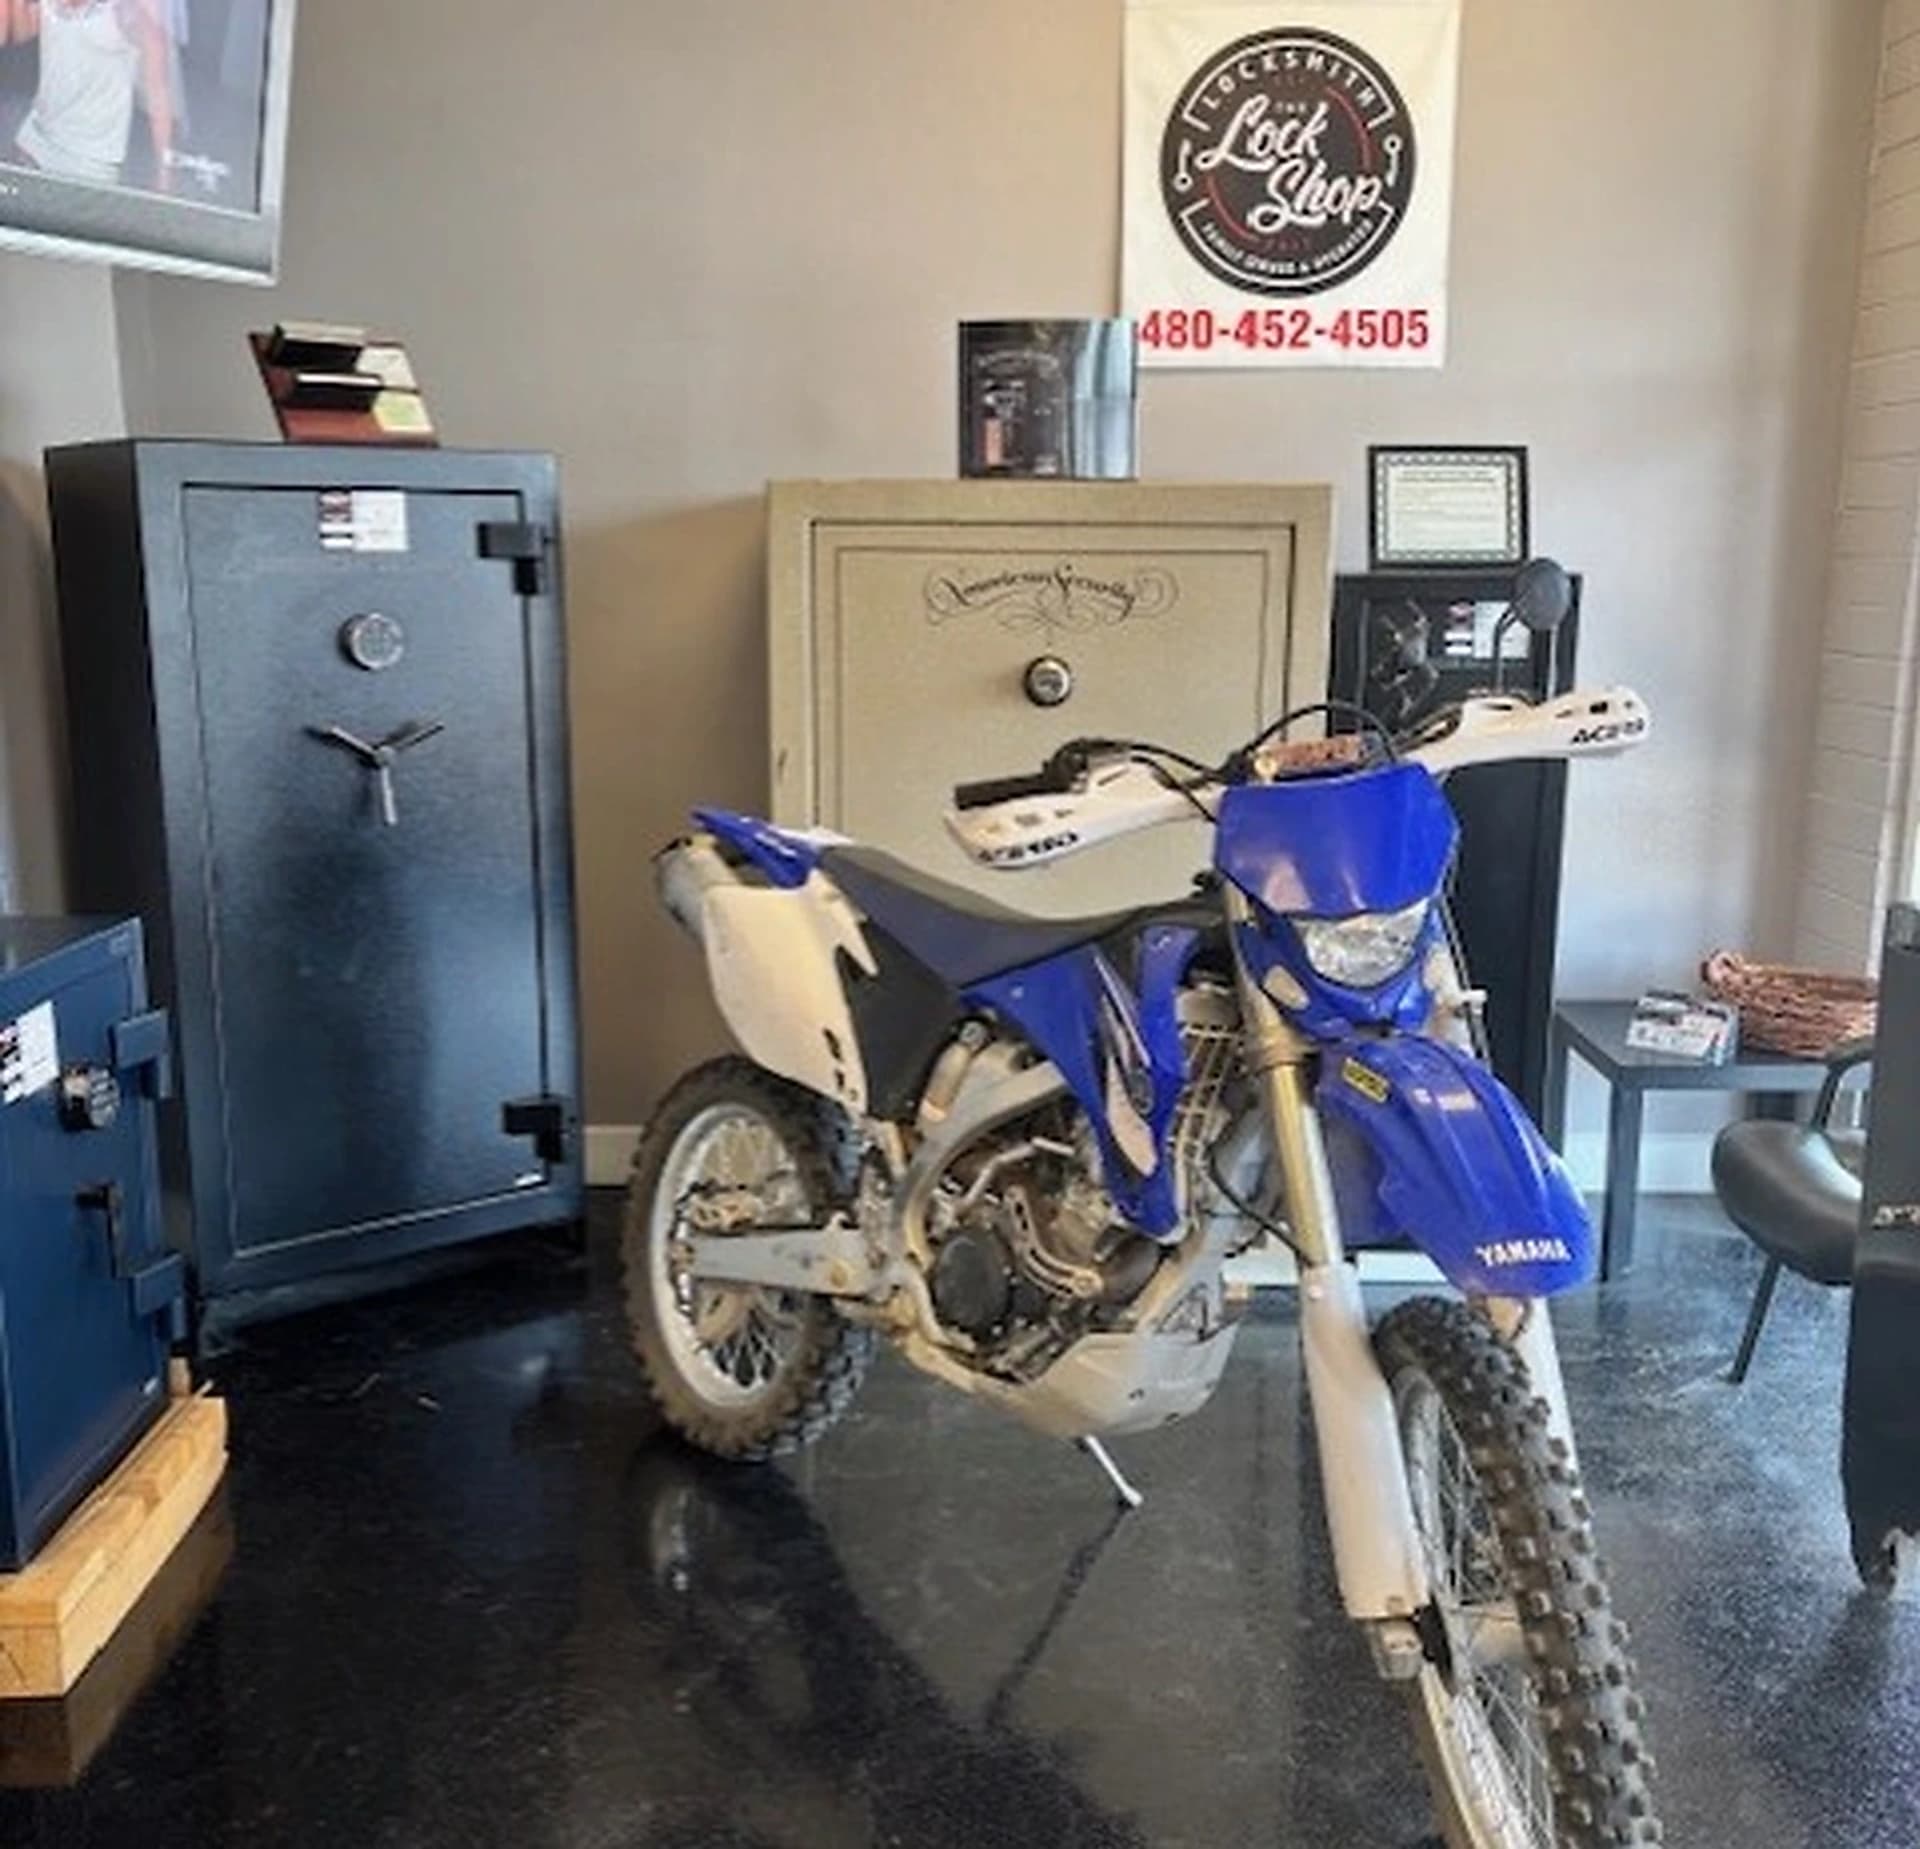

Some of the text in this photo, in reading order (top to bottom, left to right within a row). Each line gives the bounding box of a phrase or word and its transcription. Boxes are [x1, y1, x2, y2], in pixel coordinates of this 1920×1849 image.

[1202, 51, 1377, 110] LOCKSMITH
[1195, 94, 1328, 173] Lock
[1248, 159, 1382, 233] Shop
[1140, 309, 1430, 349] 480-452-4505
[1474, 1239, 1572, 1267] YAMAHA
